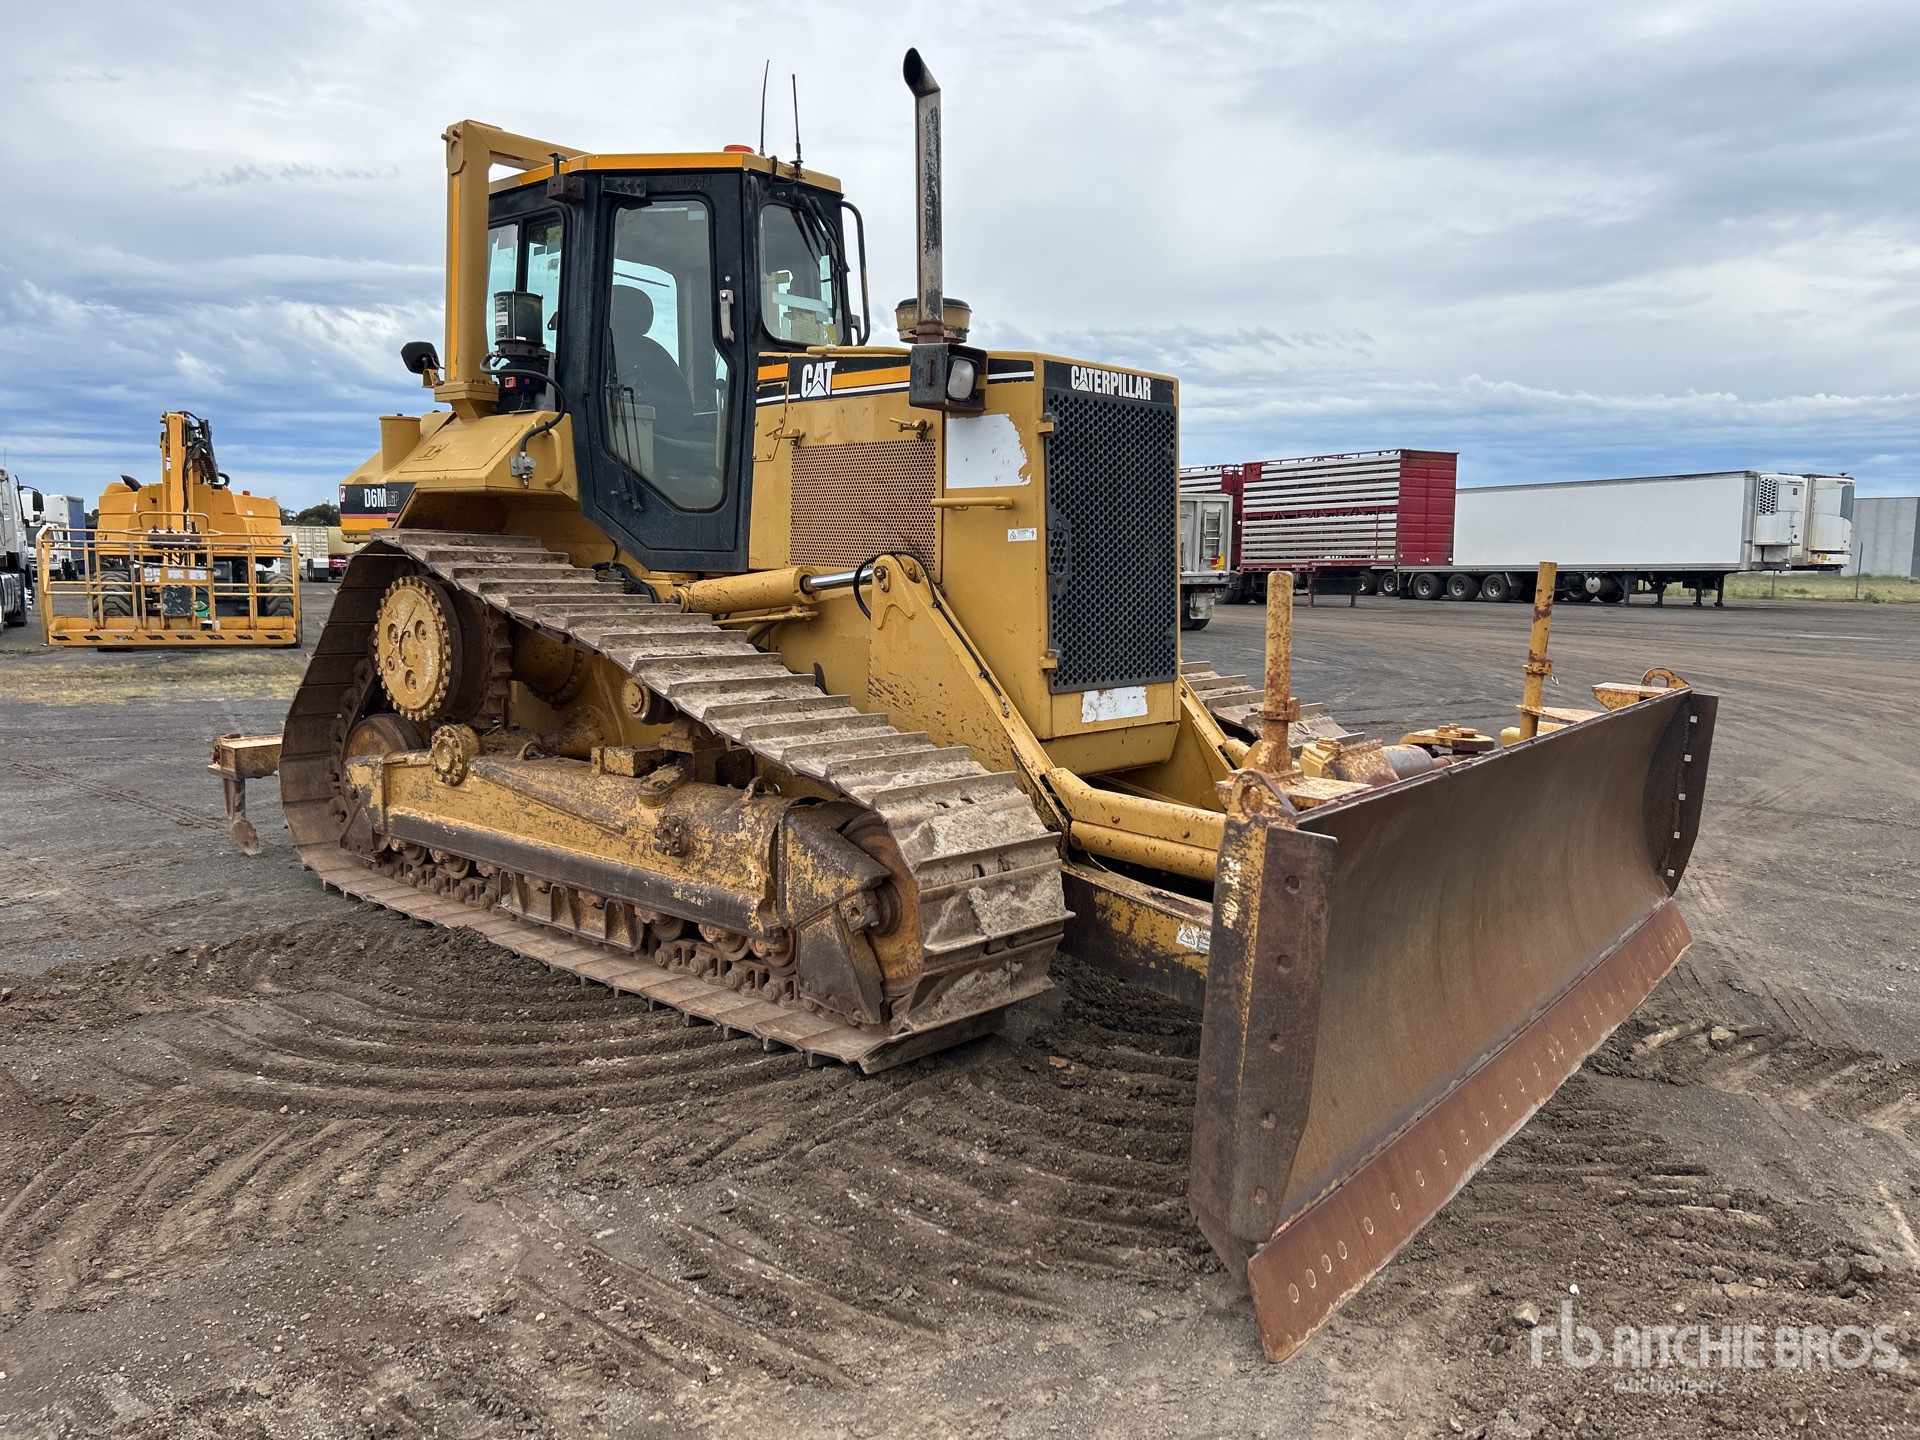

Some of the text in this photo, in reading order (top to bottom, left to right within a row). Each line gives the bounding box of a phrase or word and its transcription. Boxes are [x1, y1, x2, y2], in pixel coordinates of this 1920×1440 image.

[801, 361, 837, 398] CAT
[1071, 365, 1151, 401] CATERPILLAR
[364, 488, 387, 508] D6M
